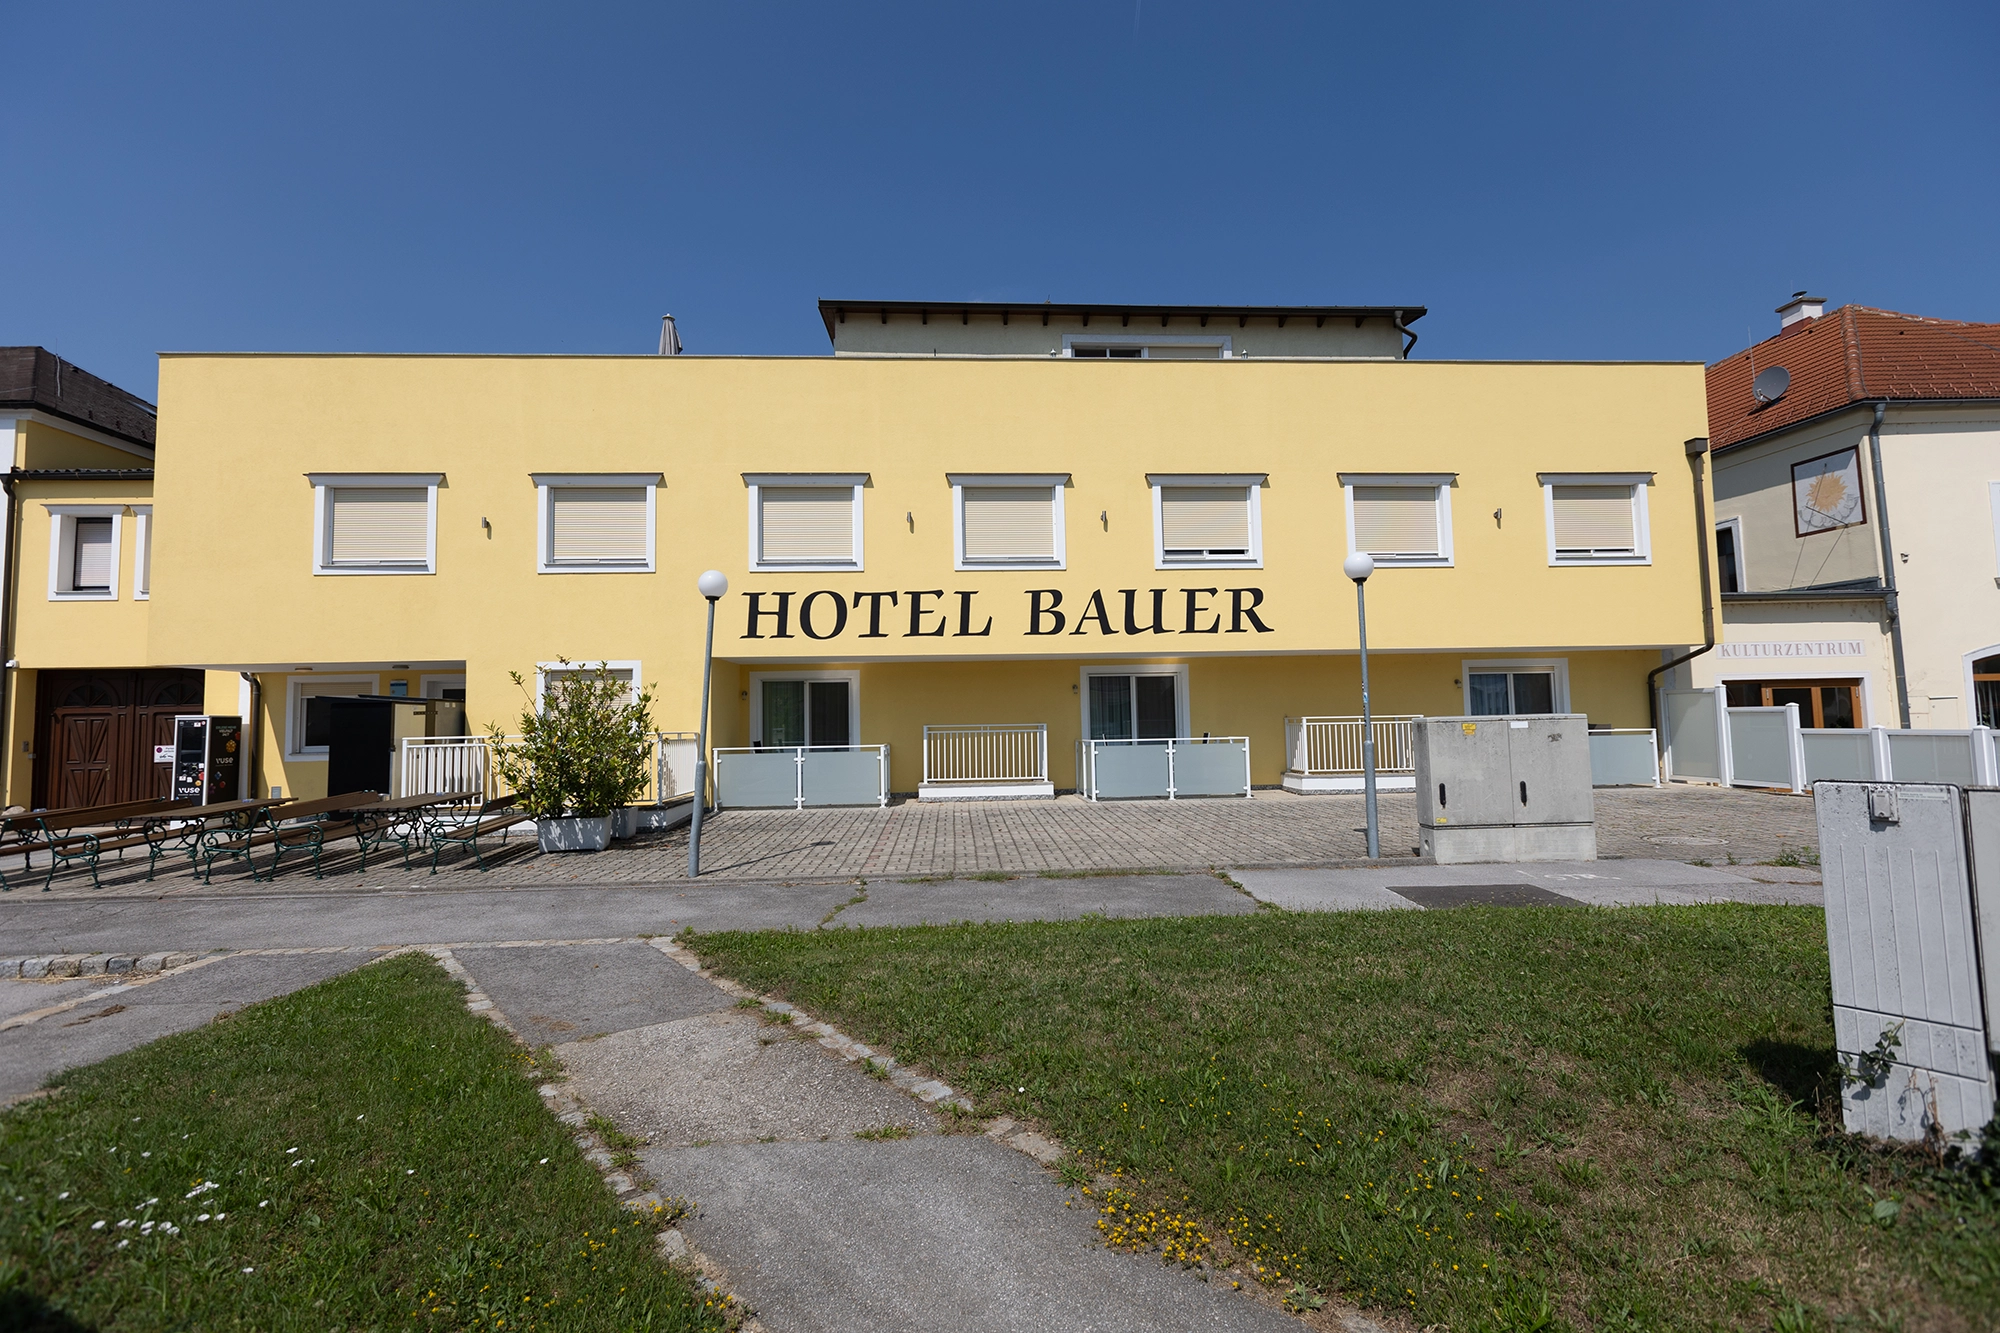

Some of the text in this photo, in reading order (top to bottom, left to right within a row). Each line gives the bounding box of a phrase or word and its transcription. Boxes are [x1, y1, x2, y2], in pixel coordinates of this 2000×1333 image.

[740, 587, 1275, 639] HOTEL BAUER
[1721, 642, 1862, 657] KULTURZENTRUM
